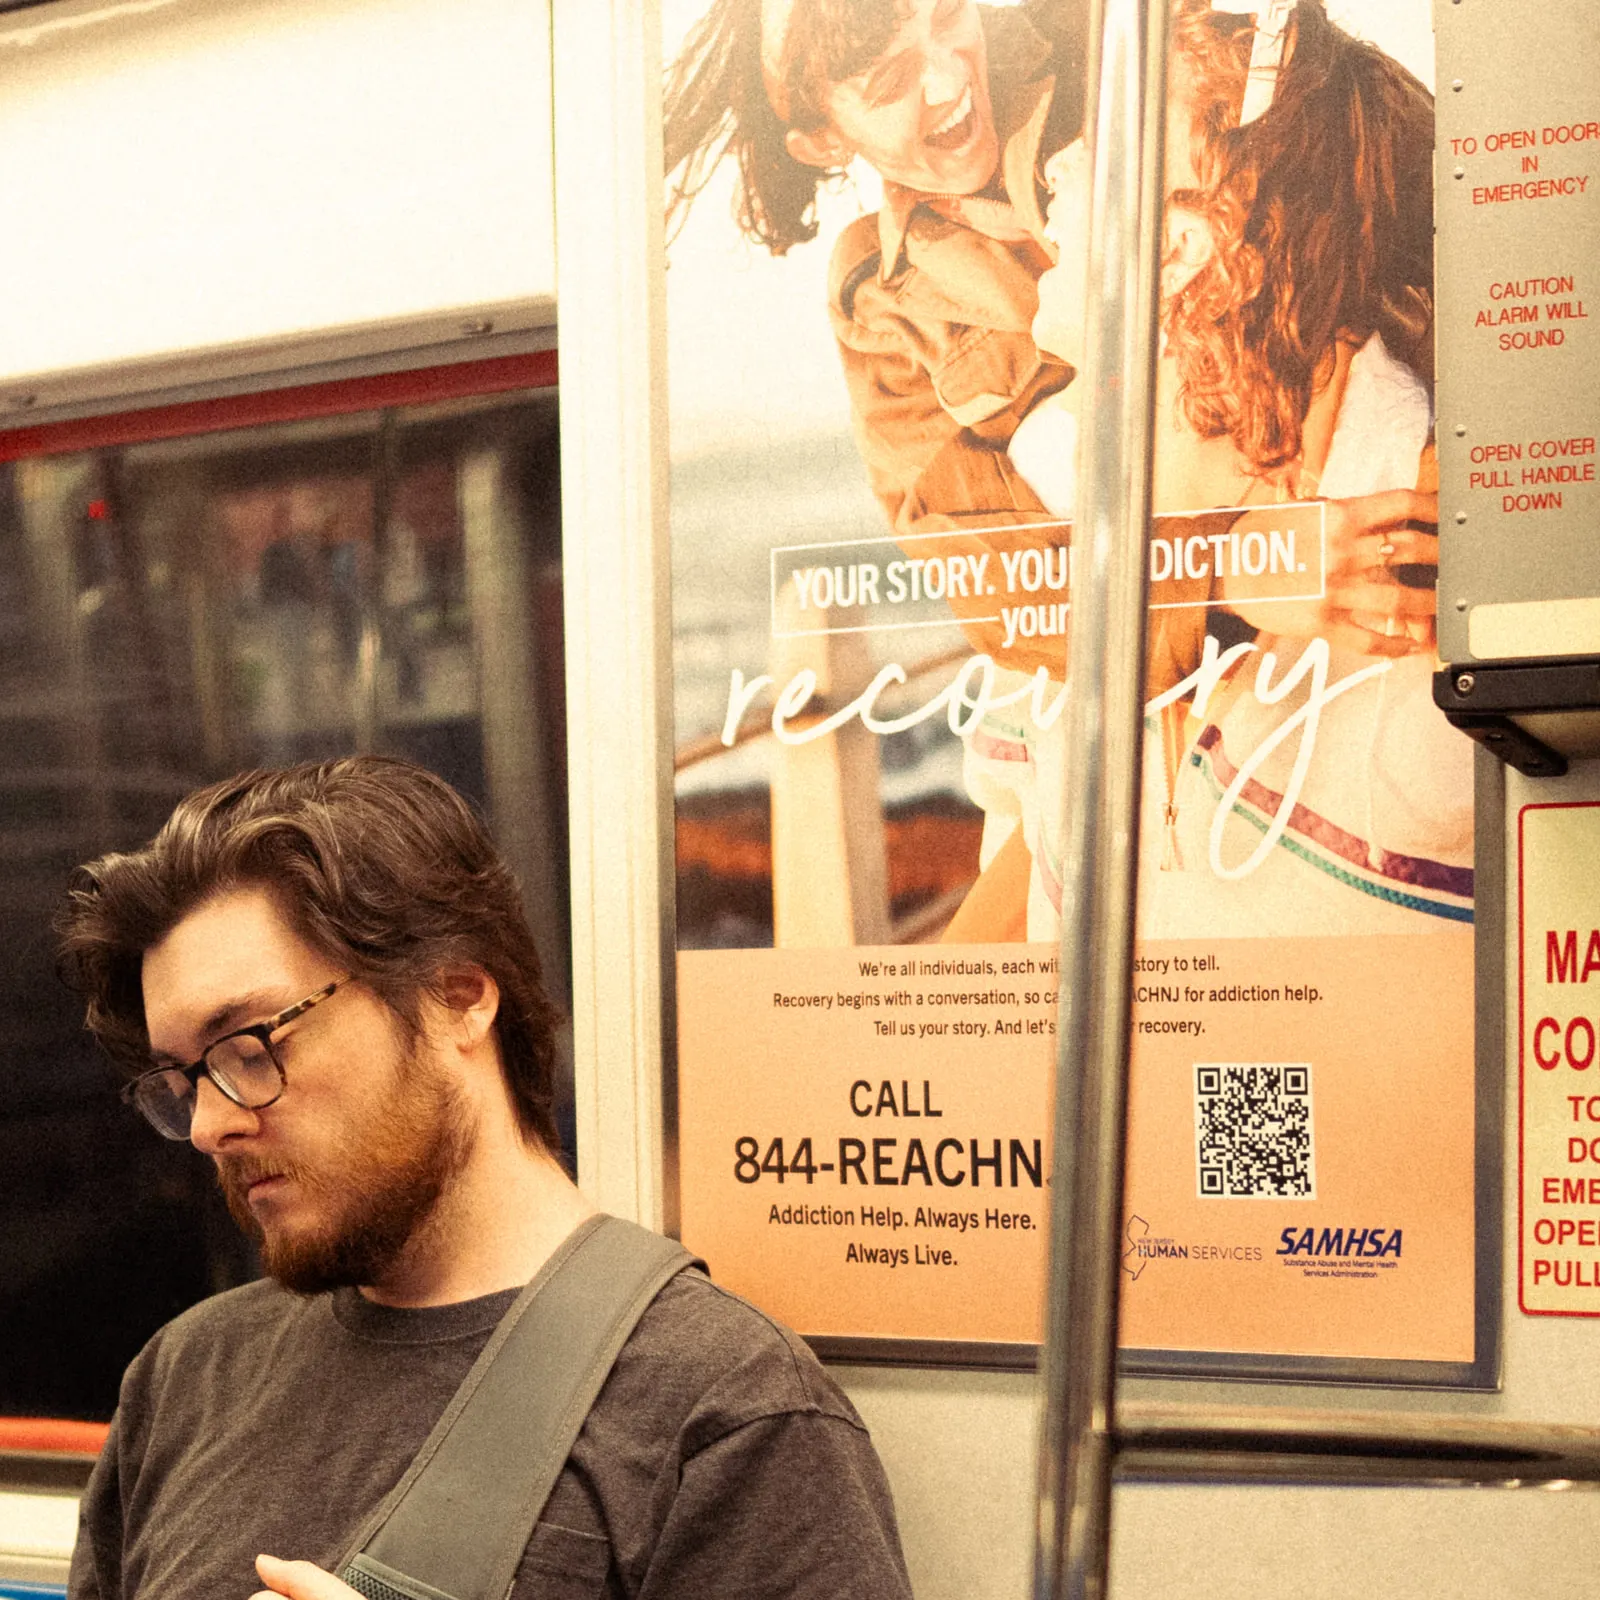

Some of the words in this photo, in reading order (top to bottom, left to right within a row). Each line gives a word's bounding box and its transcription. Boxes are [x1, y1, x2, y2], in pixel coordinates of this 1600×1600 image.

[1450, 138, 1477, 156] TO
[1484, 130, 1536, 151] OPEN
[1542, 122, 1600, 145] DOOR
[1521, 156, 1539, 173] IN
[1472, 176, 1589, 205] EMERGENCY
[1489, 275, 1574, 300] CAUTION
[1474, 305, 1539, 328] ALARM
[1546, 301, 1589, 320] WILL
[1498, 328, 1565, 351] SOUND
[1470, 444, 1522, 464] OPEN
[1528, 437, 1595, 459] COVER
[1469, 470, 1514, 489] PULL
[1521, 464, 1595, 485] HANDLE
[1502, 492, 1563, 513] DOWN
[794, 562, 879, 609] YOUR
[886, 554, 995, 604] STORY.
[1000, 546, 1072, 593] YOU
[721, 637, 1393, 879] recovry
[858, 961, 897, 977] We're
[900, 960, 916, 976] all
[919, 959, 998, 977] individuals,
[1001, 958, 1035, 975] each
[1134, 956, 1170, 975] story
[1174, 956, 1189, 971] to
[1193, 955, 1220, 971] tell.
[773, 992, 834, 1010] Recovery
[837, 991, 881, 1010] begins
[884, 990, 912, 1006] with
[915, 994, 924, 1006] a
[927, 990, 1020, 1007] conversation,
[1024, 991, 1040, 1004] so
[1184, 986, 1204, 1002] for
[1209, 985, 1280, 1002] addiction
[1284, 985, 1323, 1004] help.
[873, 1020, 896, 1036] Tell
[900, 1023, 916, 1036] us
[919, 1023, 949, 1039] your
[952, 1021, 991, 1039] story.
[994, 1020, 1022, 1036] And
[1026, 1019, 1057, 1035] let's
[1138, 1020, 1206, 1037] recovery.
[1533, 1016, 1600, 1071] CO
[849, 1080, 943, 1117] CALL
[734, 1136, 1052, 1188] 844-REACHN
[768, 1204, 855, 1226] Addiction
[860, 1206, 909, 1231] Help.
[914, 1207, 979, 1233] Always
[985, 1209, 1037, 1230] Here.
[1275, 1227, 1403, 1257] SAMHSA
[1534, 1219, 1600, 1246] OPE
[846, 1243, 909, 1268] Always
[915, 1244, 958, 1266] Live.
[1138, 1245, 1188, 1258] HUMAN
[1192, 1245, 1262, 1260] SERVICES
